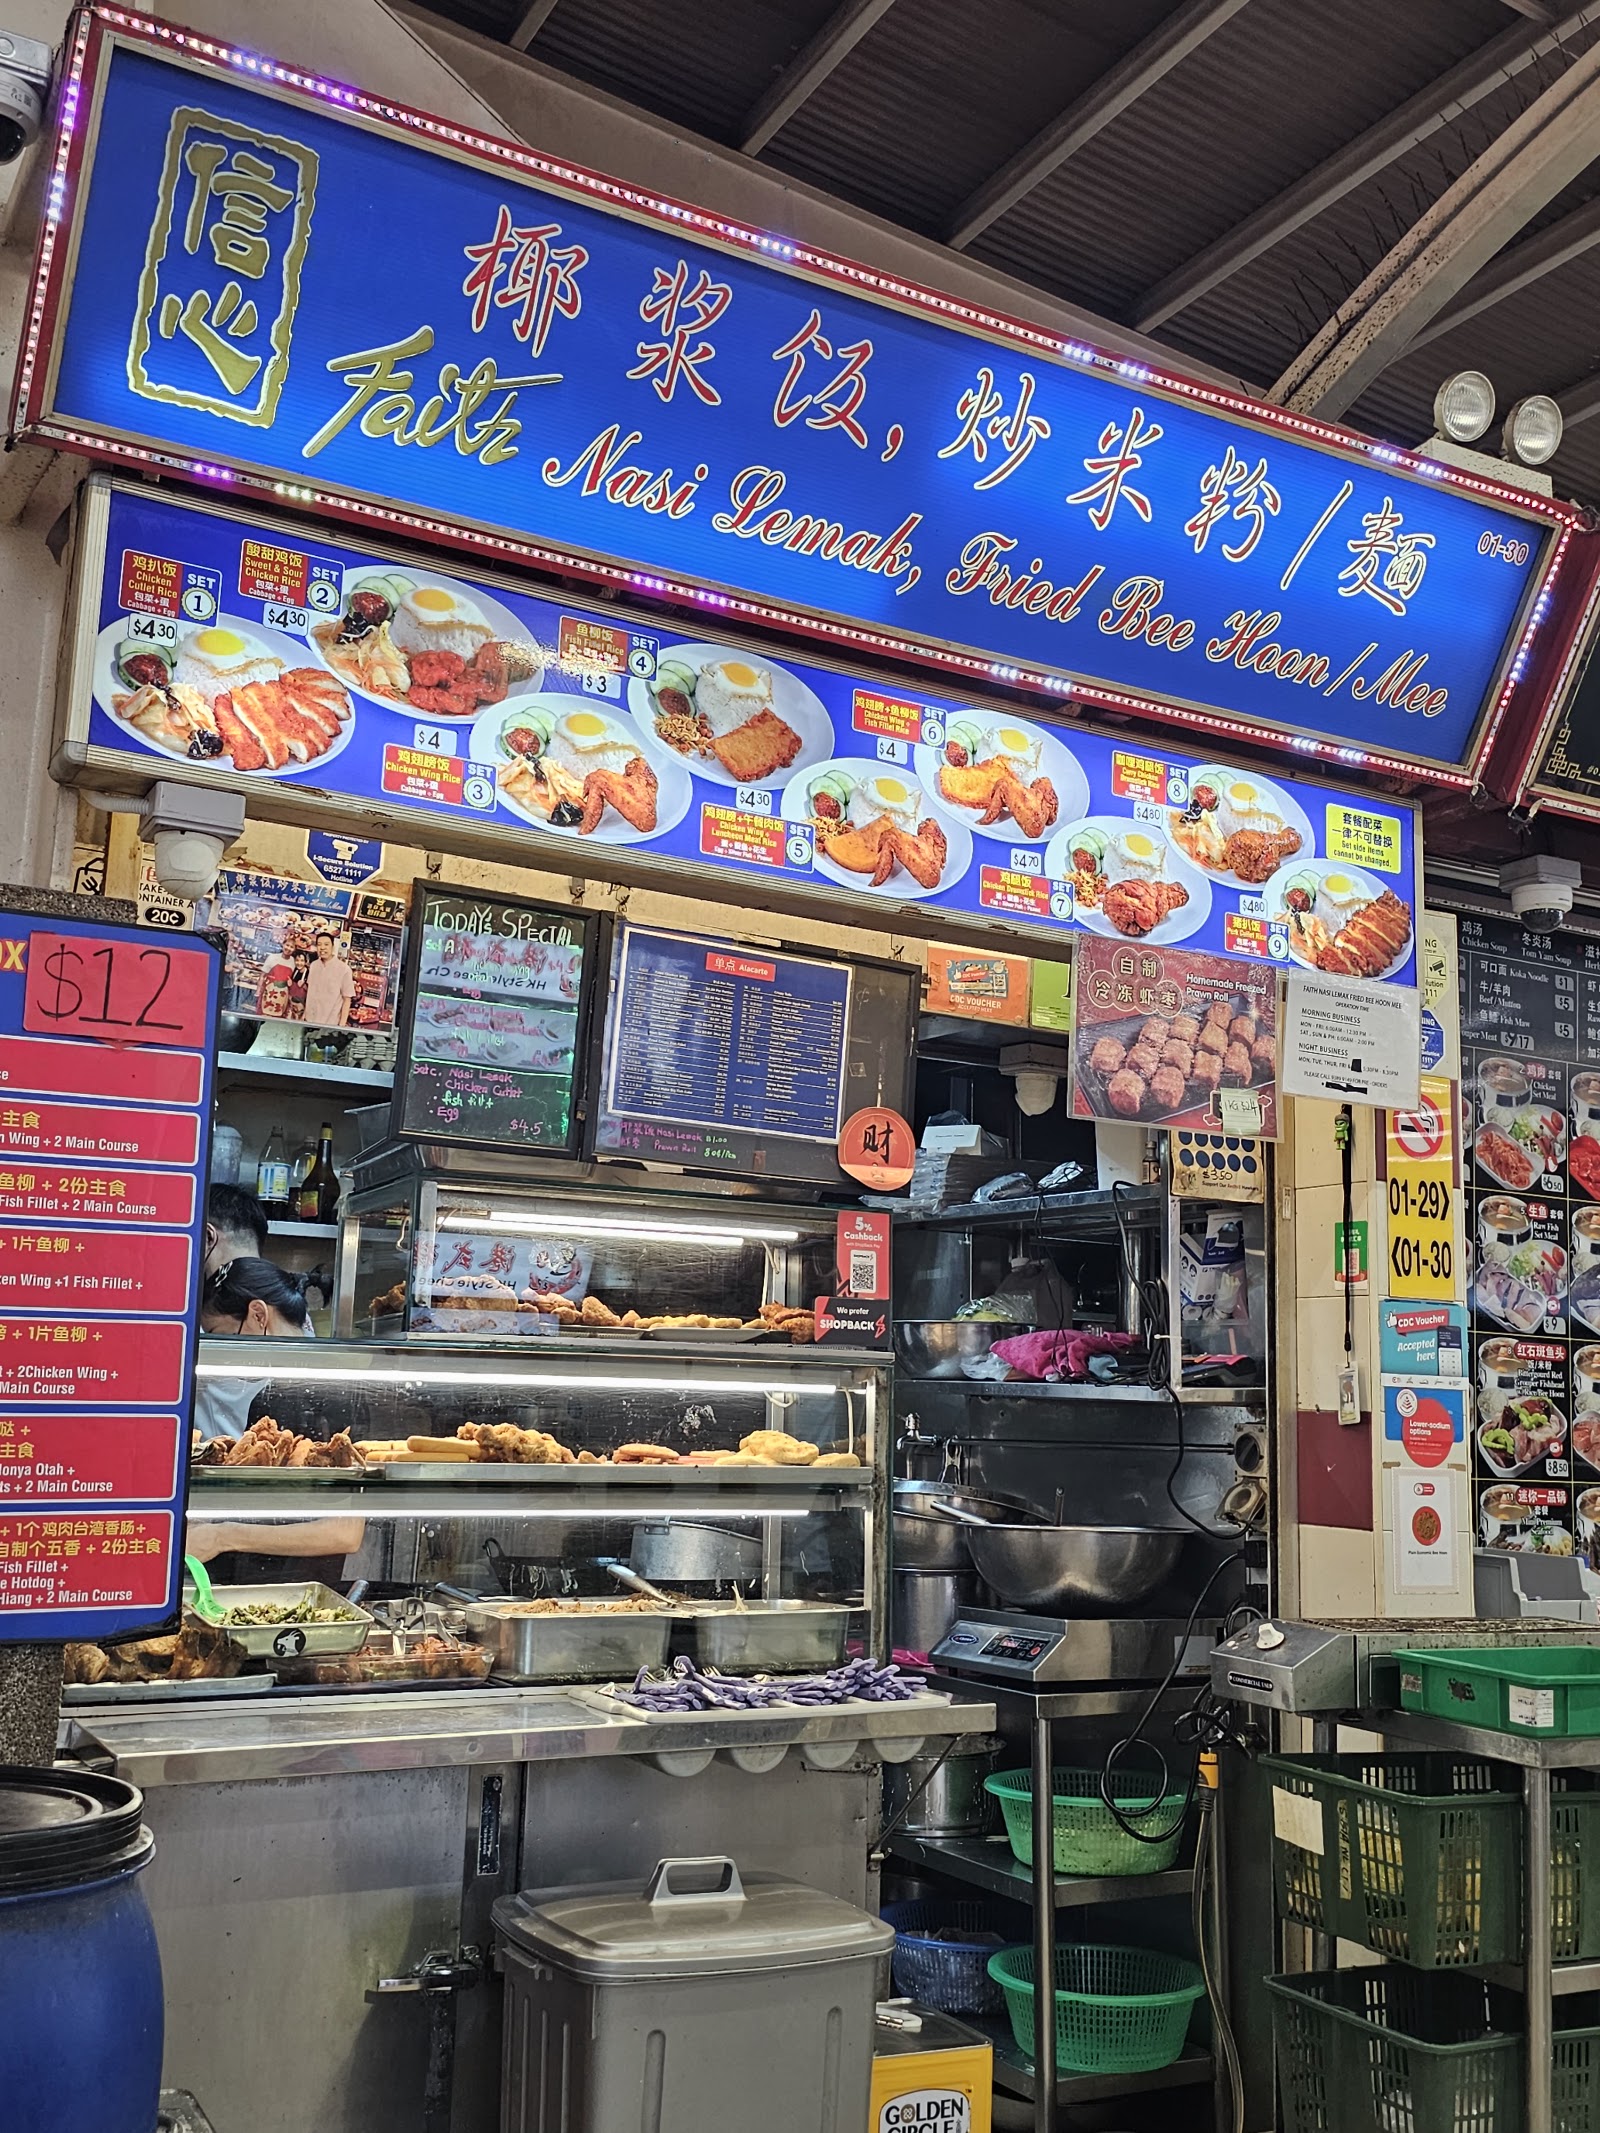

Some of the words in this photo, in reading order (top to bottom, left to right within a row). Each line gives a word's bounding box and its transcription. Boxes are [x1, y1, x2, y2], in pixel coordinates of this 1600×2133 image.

[160, 141, 294, 394] 信心
[302, 325, 563, 466] Faith
[542, 422, 709, 520] Nasi
[712, 464, 924, 596] Lemak,
[945, 531, 1105, 624] Fried
[1099, 576, 1196, 652] Bee
[246, 543, 303, 568] 酸甜鸡饭
[1477, 529, 1531, 567] 01-30
[132, 555, 176, 577] 鸡扒饭
[245, 557, 271, 572] Sweet
[274, 564, 280, 573] &
[283, 566, 303, 578] Sour
[137, 571, 171, 587] Chicken
[187, 574, 216, 589] SET
[245, 567, 279, 583] Chicken
[282, 576, 300, 588] Rice
[312, 567, 339, 582] SET
[128, 579, 155, 592] Cutlet
[158, 587, 177, 598] Rice
[249, 587, 276, 600] Cabbage
[282, 595, 295, 605] Egg
[316, 587, 328, 605] 2
[127, 600, 155, 612] Cabbage
[163, 605, 176, 618] Egg
[193, 595, 203, 613] 1
[576, 623, 613, 643] 鱼柳饭
[565, 633, 582, 645] Fish
[584, 638, 605, 650] Fillet
[606, 644, 624, 656] Rice
[632, 636, 655, 650] SET
[636, 656, 647, 671] 4
[924, 708, 944, 720] SET
[929, 726, 936, 739] 6
[397, 750, 450, 772] 鸡翅膀饭
[386, 762, 417, 775] Chicken
[420, 768, 440, 781] Wing
[443, 773, 461, 784] Rice
[468, 764, 493, 778] SET
[1170, 767, 1187, 779] SET
[473, 784, 483, 800] 3
[1174, 784, 1180, 797] 8
[1343, 812, 1382, 832] 套餐配菜
[789, 824, 811, 837] SET
[1332, 827, 1392, 849] 一律不可替换
[794, 843, 803, 857] 5
[1342, 840, 1351, 849] Set
[1354, 843, 1365, 852] side
[1334, 850, 1354, 859] cannot
[1356, 853, 1363, 861] be
[324, 865, 343, 874] 6527
[345, 869, 362, 877] 1111
[344, 859, 373, 871] Solution
[1053, 881, 1071, 893] SET
[1056, 898, 1065, 912] 7
[499, 909, 579, 948] SPECIAL
[1270, 924, 1287, 934] SET
[1462, 921, 1482, 936] 鸡汤
[1274, 940, 1281, 952] 9
[1462, 936, 1489, 949] Chicken
[1490, 942, 1507, 954] Soup
[1521, 932, 1552, 949] 冬炎汤
[715, 957, 736, 972] 单点
[739, 964, 769, 976] Alacarte
[1120, 957, 1156, 978] 自制
[1480, 960, 1507, 976] 可口面
[37, 942, 184, 1030] $12
[1186, 973, 1234, 989] Homemade
[1235, 982, 1267, 995] Freezed
[950, 994, 964, 1003] CDC
[966, 998, 1002, 1009] VOUCHER
[1095, 979, 1176, 1010] 冷冻虾枣
[1186, 987, 1212, 1000] Prawn
[1213, 991, 1229, 1002] Roll
[1332, 990, 1350, 999] LEMAK
[1350, 994, 1364, 1002] FRIED
[1375, 999, 1390, 1007] HOON
[1302, 1008, 1331, 1019] MORNING
[1332, 1013, 1360, 1023] BUSINESS
[1299, 1042, 1317, 1051] NIGHT
[1320, 1045, 1348, 1056] BUSINESS
[445, 1080, 488, 1093] Chicken
[437, 1106, 459, 1123] Egg
[9, 1131, 40, 1147] Wing
[54, 1136, 61, 1147] 2
[66, 1136, 95, 1150] Main
[99, 1138, 139, 1153] Course
[861, 1121, 894, 1165] 财
[59, 1177, 126, 1197] 2份主食
[0, 1195, 23, 1208] Fish
[27, 1197, 58, 1210] Fillet
[73, 1199, 80, 1211] 2
[84, 1200, 112, 1213] Main
[117, 1202, 156, 1215] Course
[1390, 1177, 1438, 1218] 01-29
[1529, 1204, 1548, 1219] 生鱼
[855, 1217, 873, 1232] 5%
[12, 1235, 70, 1253] 1片鱼柳
[844, 1231, 883, 1242] Cashback
[1401, 1239, 1452, 1279] 01-30
[21, 1273, 51, 1289] Wing
[74, 1276, 98, 1288] Fish
[102, 1277, 132, 1289] Fillet
[837, 1306, 847, 1314] We
[849, 1307, 870, 1316] prefer
[819, 1318, 875, 1331] SHOPBACK
[1398, 1317, 1414, 1327] CDC
[1415, 1315, 1445, 1326] Voucher
[29, 1325, 87, 1342] 1片鱼柳
[1397, 1338, 1435, 1352] Accepted
[1517, 1344, 1564, 1359] 红石斑鱼头
[1416, 1351, 1435, 1362] here
[17, 1365, 73, 1378] 2Chicken
[77, 1366, 107, 1381] Wing
[0, 1381, 29, 1394] Main
[33, 1381, 75, 1394] Course
[1409, 1419, 1450, 1430] Lower-sodium
[36, 1463, 64, 1476] Otah
[25, 1481, 33, 1493] 2
[37, 1480, 68, 1492] Main
[71, 1480, 113, 1492] Course
[101, 1538, 161, 1555] 2份主食
[26, 1560, 58, 1573] Fillet
[11, 1576, 55, 1591] Hotdog
[47, 1590, 55, 1603] 2
[58, 1590, 88, 1603] Main
[92, 1589, 133, 1602] Course
